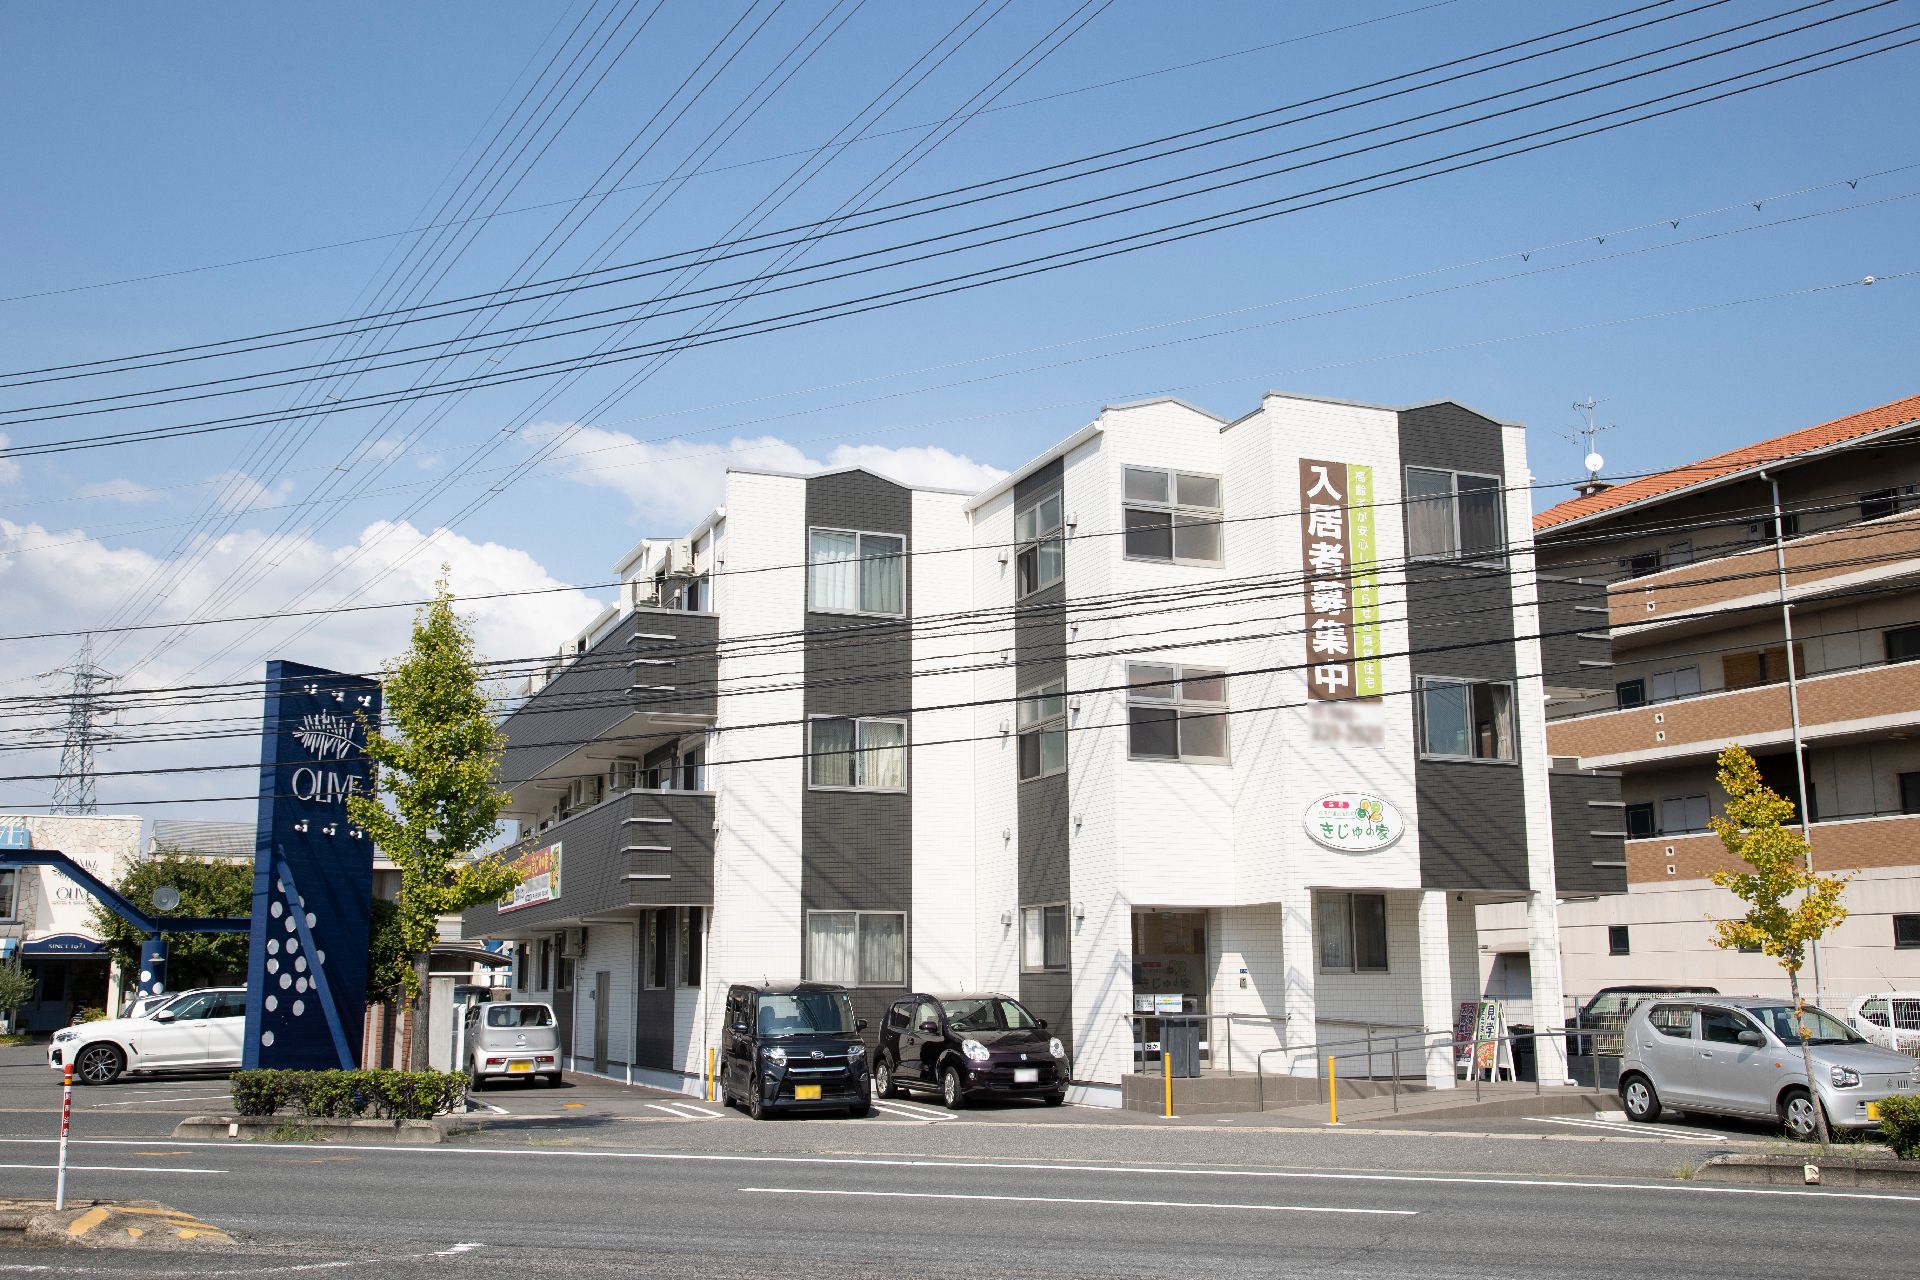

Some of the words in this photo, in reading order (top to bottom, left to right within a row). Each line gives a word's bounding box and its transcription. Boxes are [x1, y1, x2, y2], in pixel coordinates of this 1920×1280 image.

[1306, 465, 1349, 694] 入居者募集中
[292, 767, 363, 804] OLIVE
[56, 886, 90, 899] OLIV
